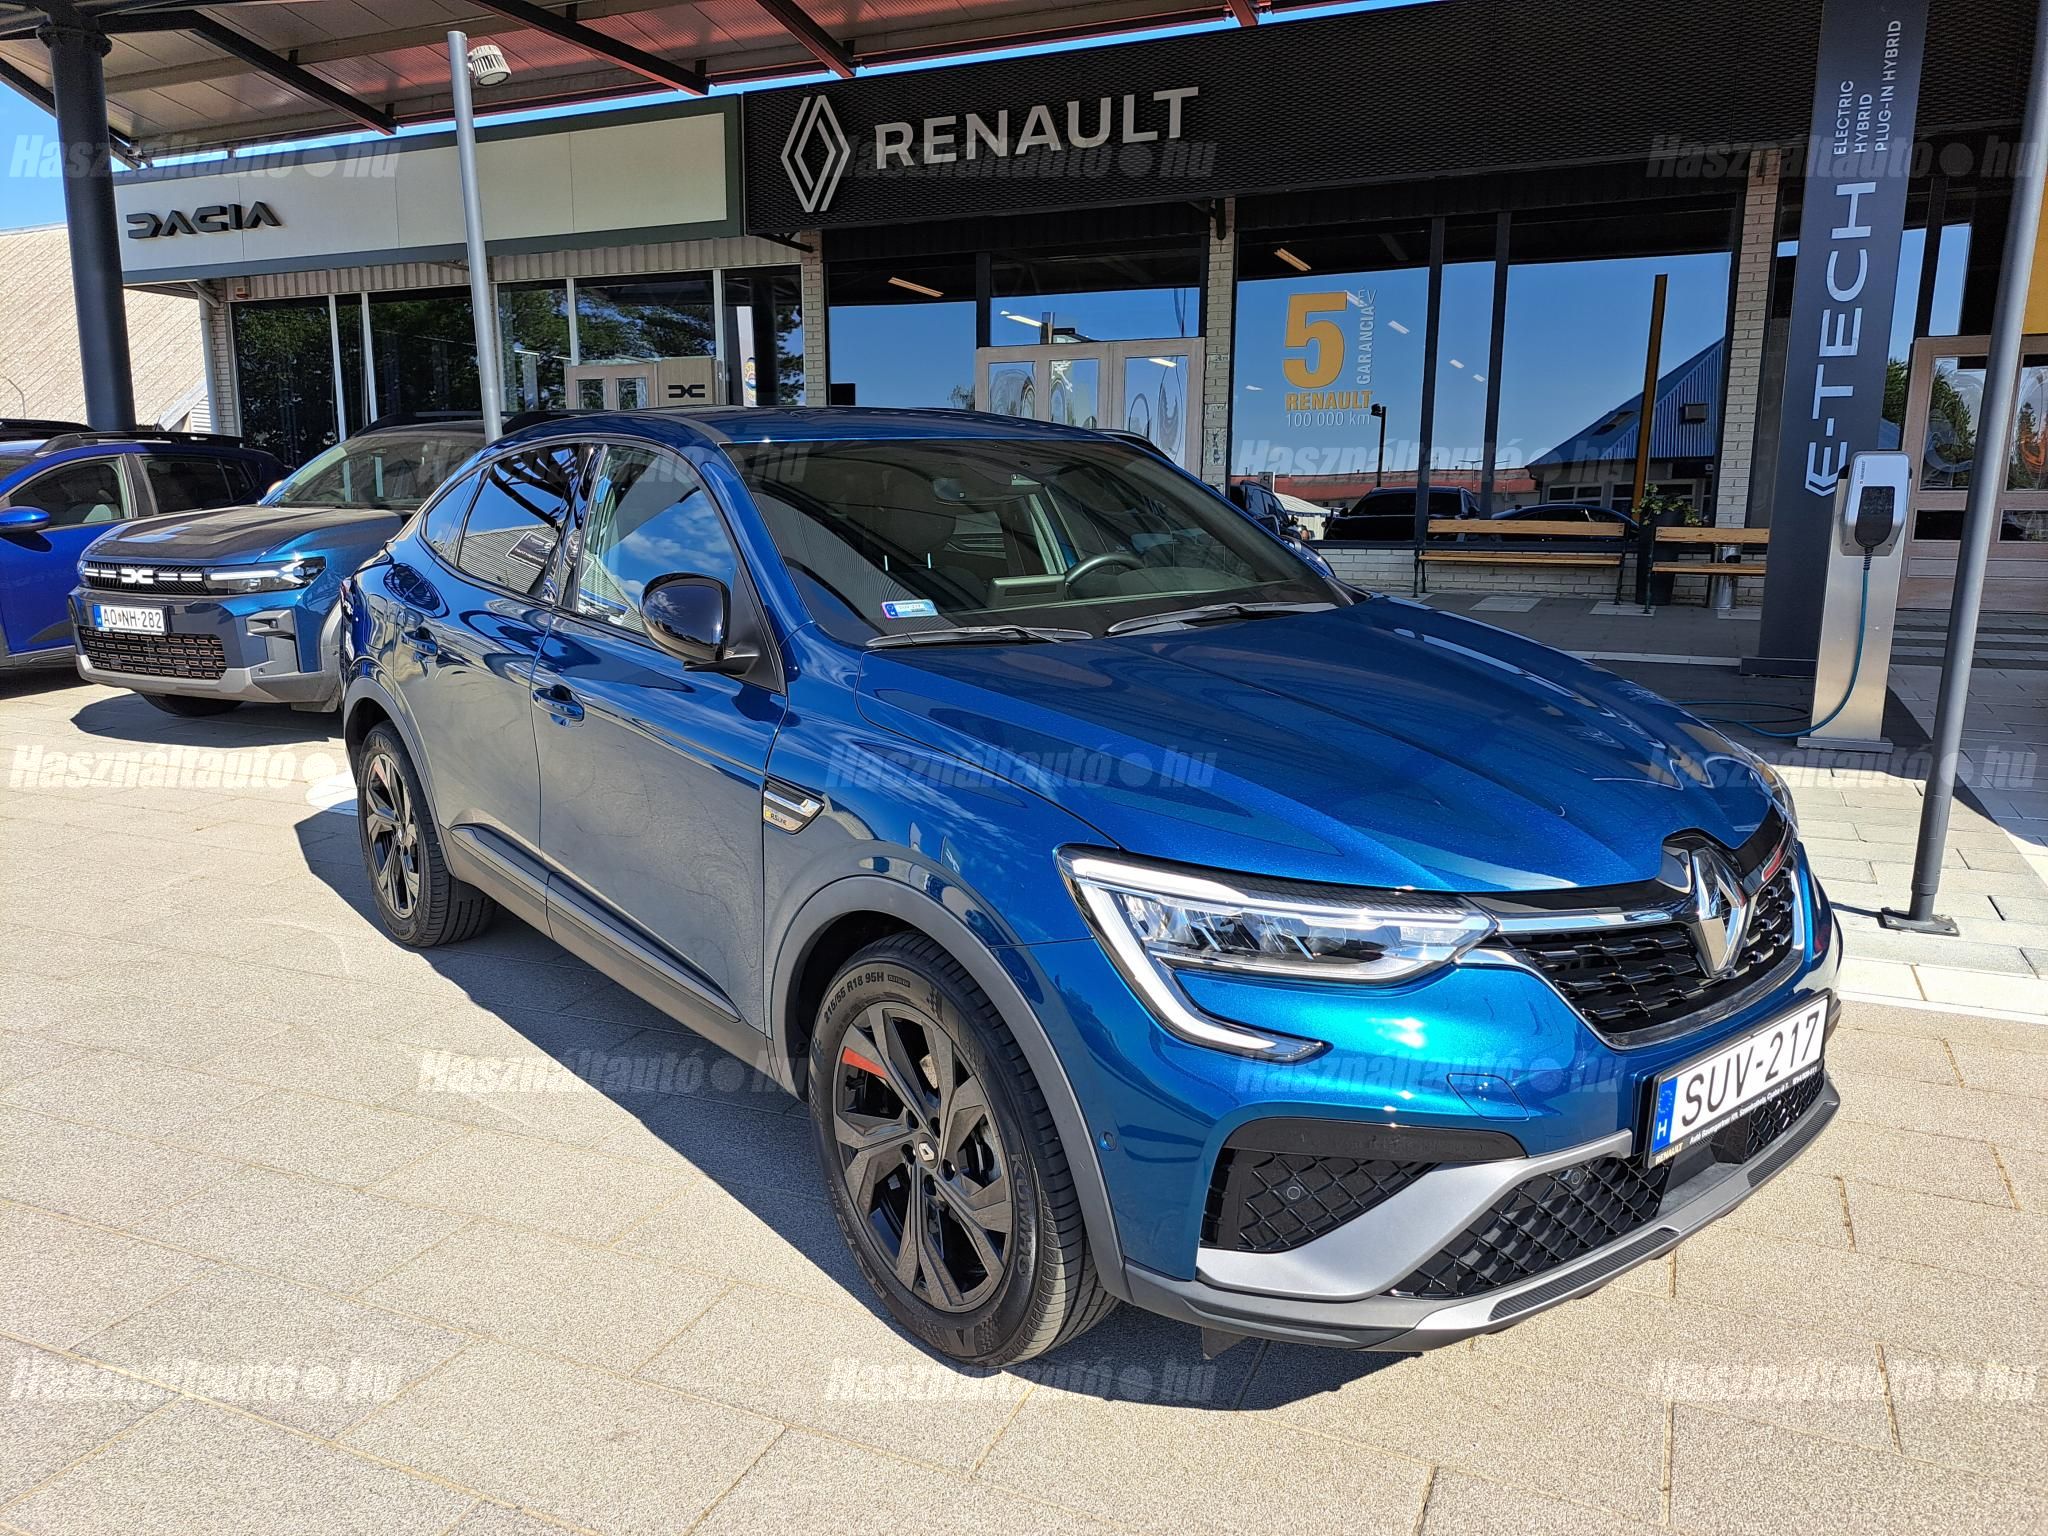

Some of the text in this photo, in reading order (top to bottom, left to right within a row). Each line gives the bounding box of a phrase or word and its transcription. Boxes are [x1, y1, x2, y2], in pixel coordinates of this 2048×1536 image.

[1833, 80, 1854, 155] ELECTRIC
[1854, 93, 1872, 153] HYBRID
[1875, 20, 1901, 151] PLUG-IN HYBRID
[874, 86, 1199, 170] RENAULT
[126, 201, 282, 239] DACIA
[1283, 291, 1348, 389] 5
[1356, 304, 1378, 385] GARANCIA
[1805, 181, 1877, 497] E-TECH
[1285, 390, 1373, 411] RENAULT
[1287, 408, 1371, 428] 100 000 km
[823, 986, 847, 1024] 215/55
[847, 976, 863, 992] R18
[865, 972, 884, 984] 95H
[1682, 1010, 1820, 1127] SUV-217
[1655, 1142, 1684, 1165] RENAULT
[1656, 1118, 1668, 1140] H
[1010, 1152, 1035, 1277] KUMHO
